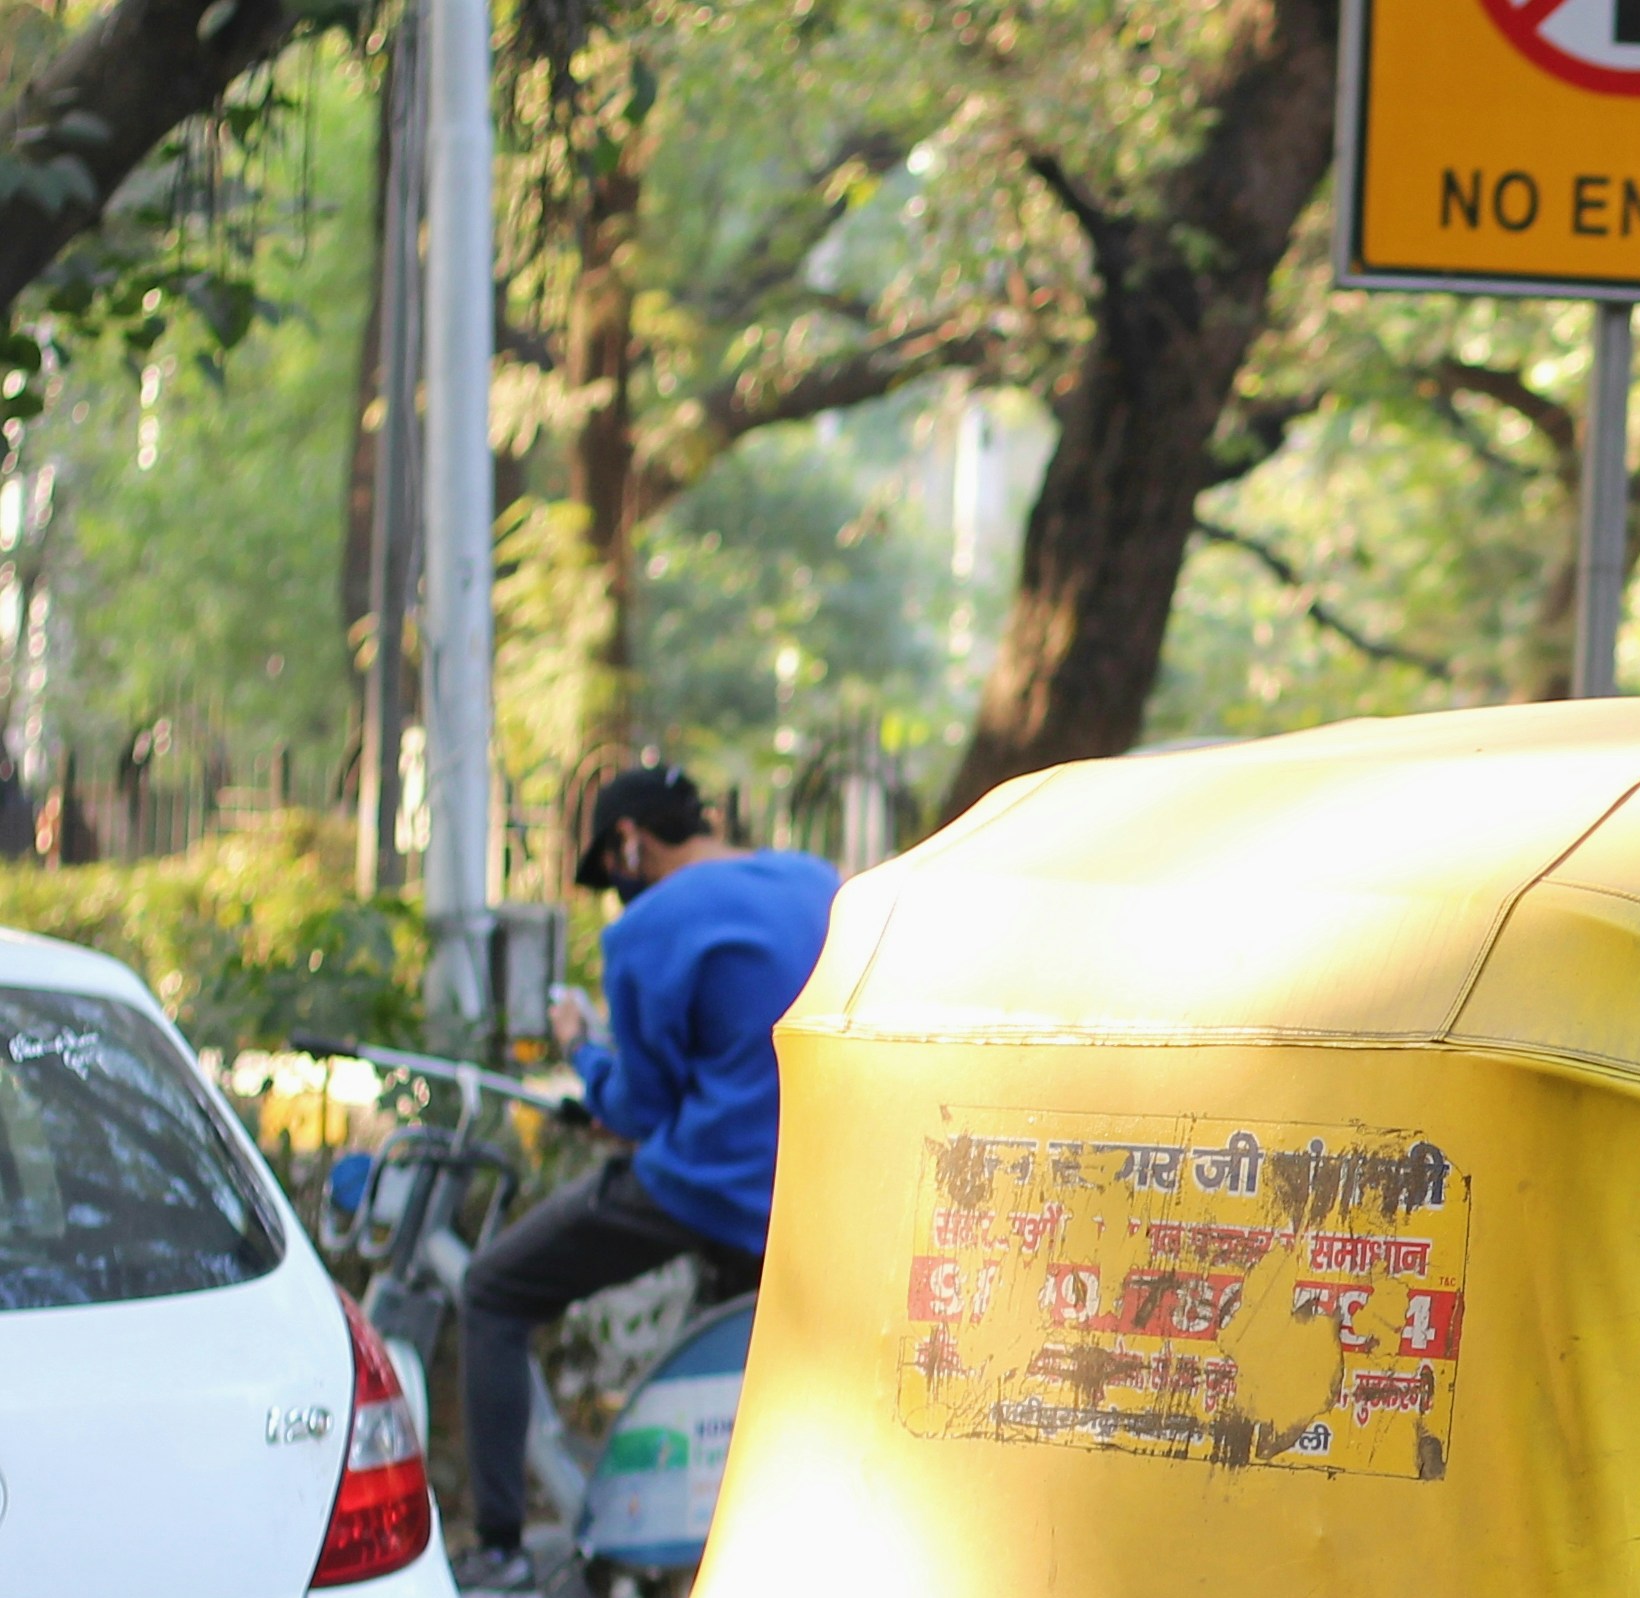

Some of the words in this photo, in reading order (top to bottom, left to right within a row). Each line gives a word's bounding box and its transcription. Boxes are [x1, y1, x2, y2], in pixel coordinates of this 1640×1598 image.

[1440, 167, 1540, 232] NO
[1191, 1131, 1263, 1194] जी
[1310, 1234, 1431, 1276] समाधान
[1439, 1276, 1457, 1287] T&C
